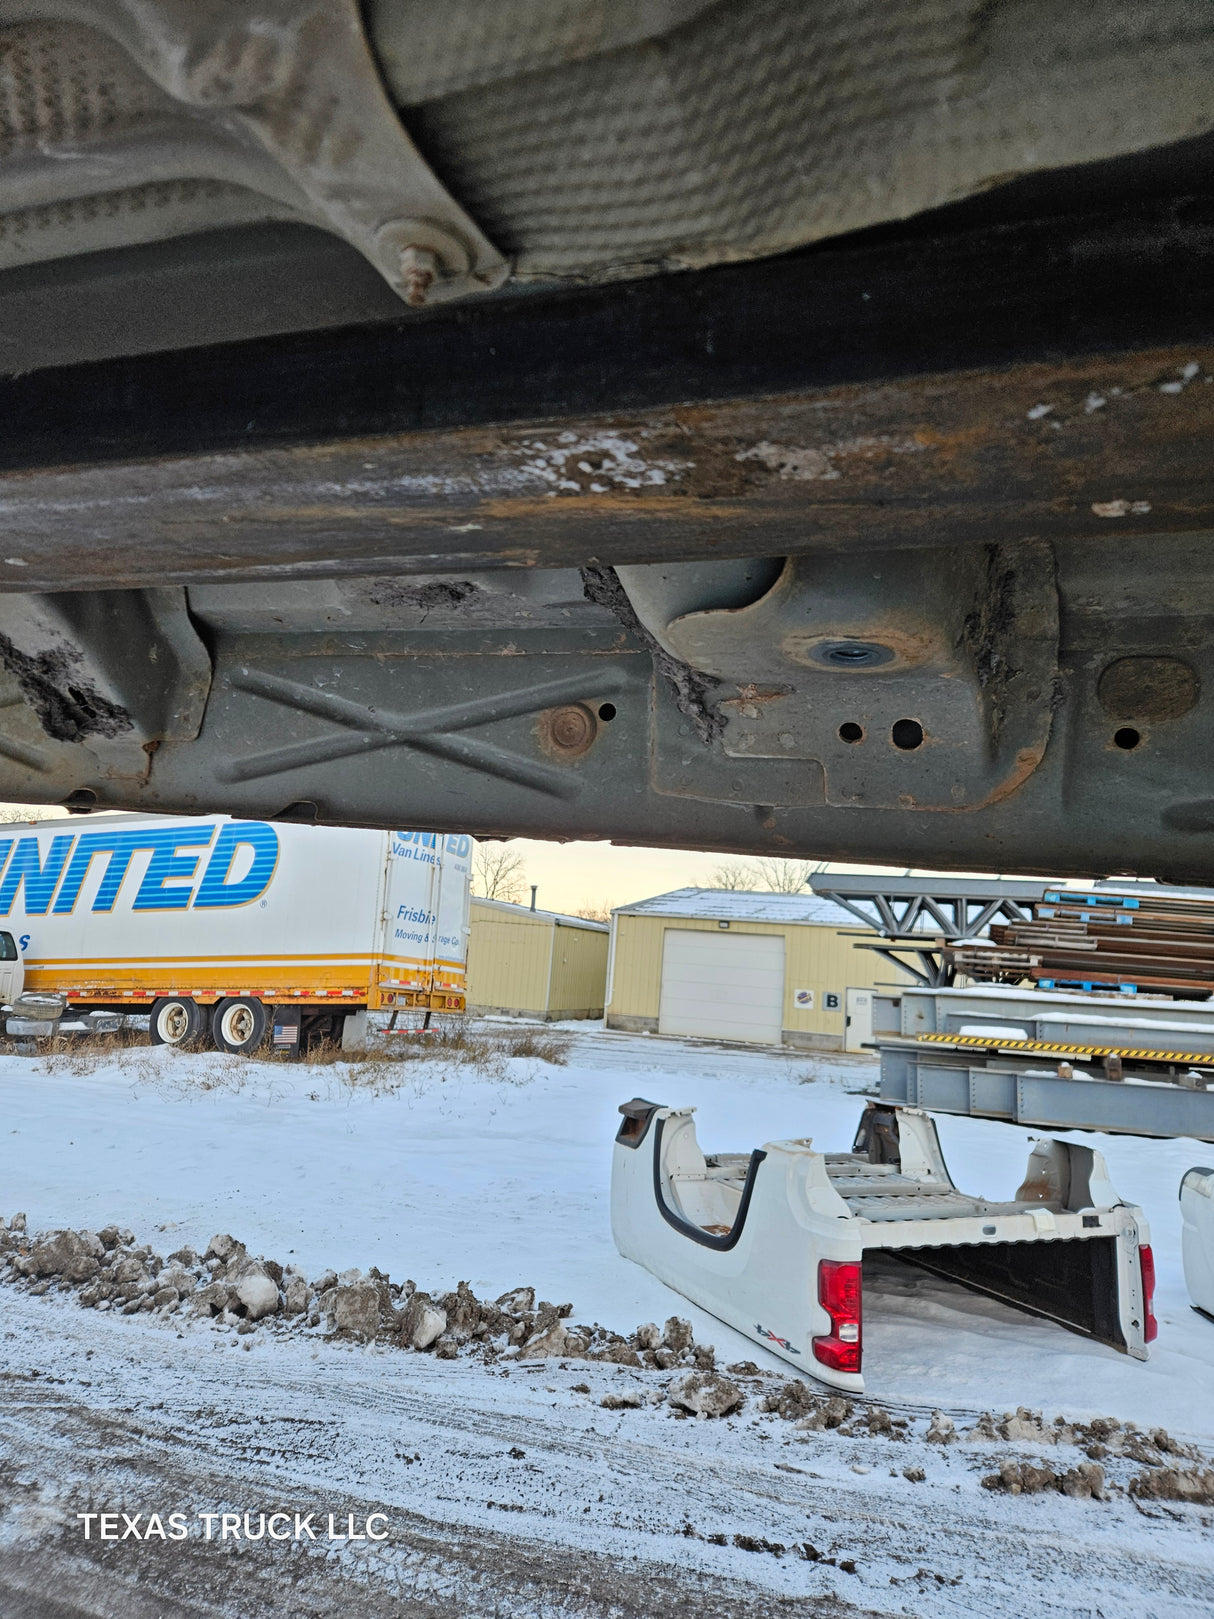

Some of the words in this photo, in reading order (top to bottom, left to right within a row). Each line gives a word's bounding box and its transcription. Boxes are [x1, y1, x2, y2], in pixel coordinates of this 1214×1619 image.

[392, 841, 412, 859] Van
[413, 847, 441, 866] Lines
[0, 821, 281, 917] NITED
[394, 928, 423, 944] Moving
[826, 994, 838, 1008] B
